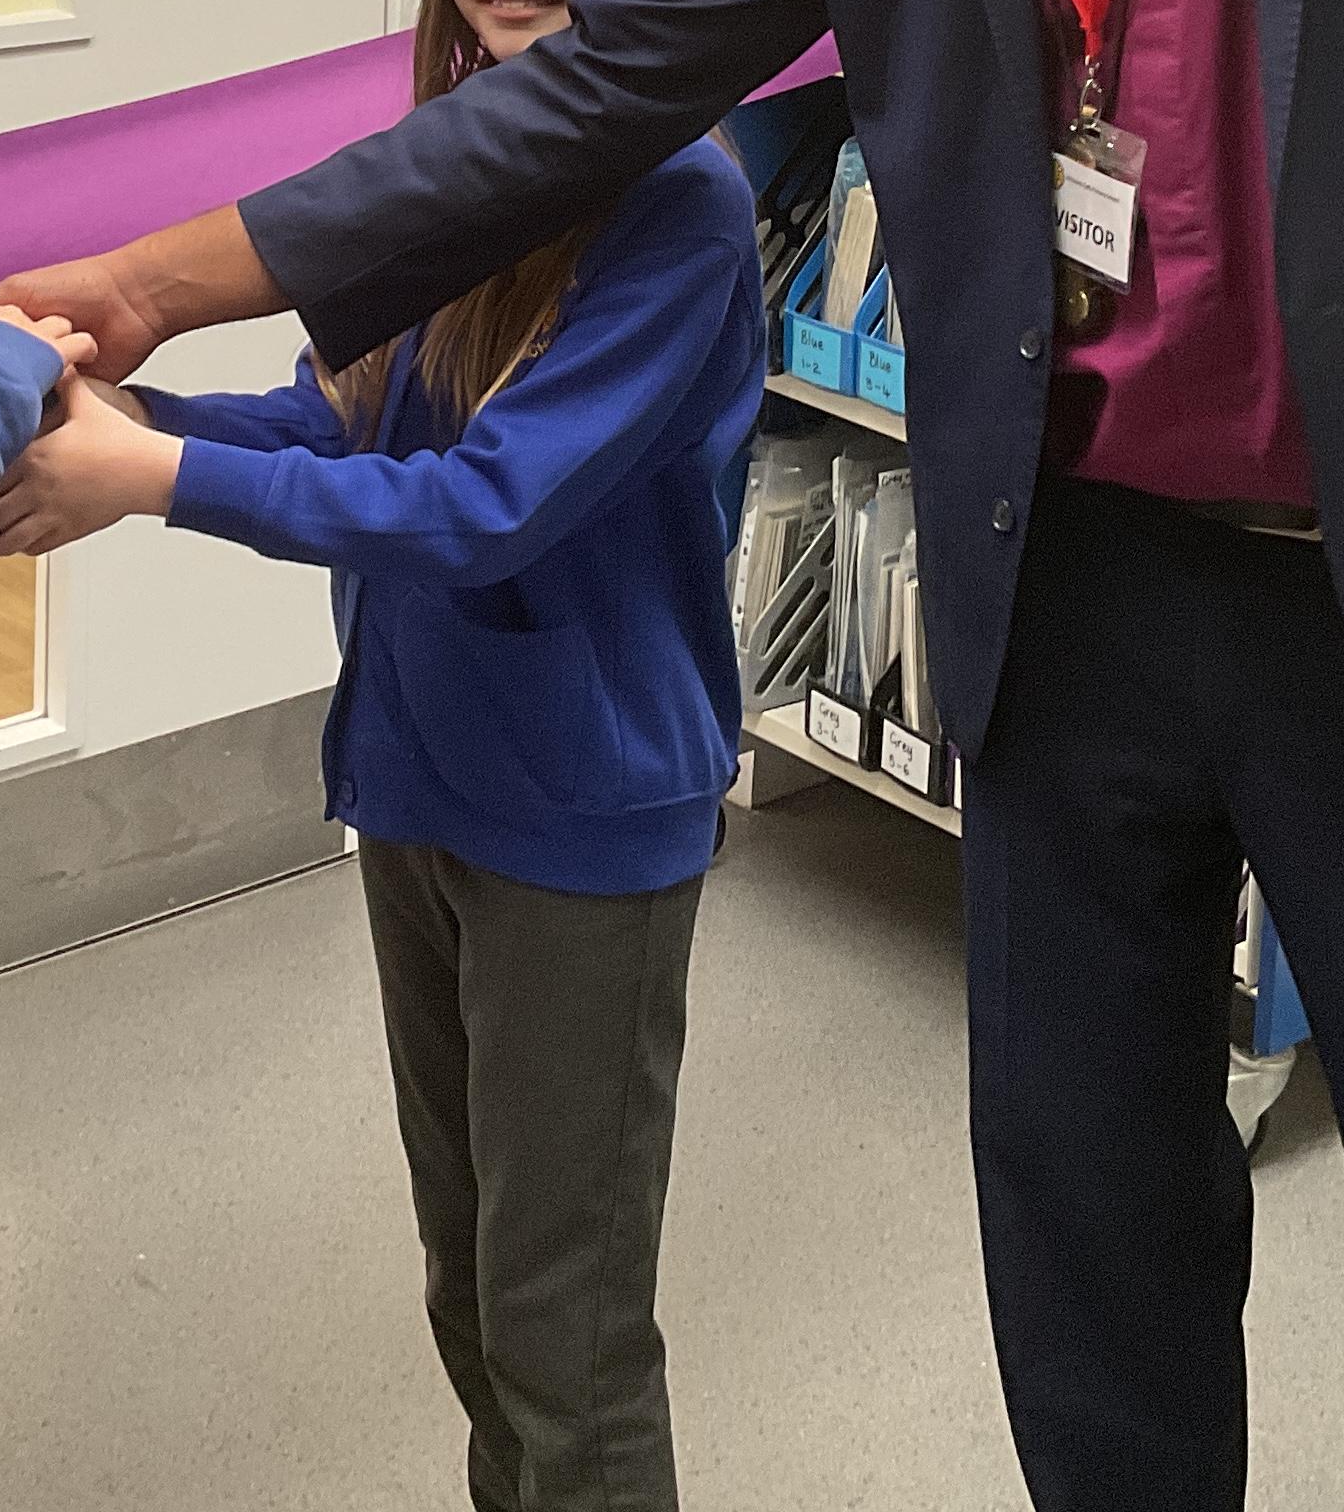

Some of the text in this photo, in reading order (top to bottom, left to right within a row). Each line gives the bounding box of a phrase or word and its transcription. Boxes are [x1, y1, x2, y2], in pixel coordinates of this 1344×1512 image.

[1054, 206, 1115, 253] VISITOR
[800, 328, 824, 351] Blue
[869, 351, 892, 373] Blue
[818, 701, 840, 729] Grey
[889, 731, 913, 762] Grey
